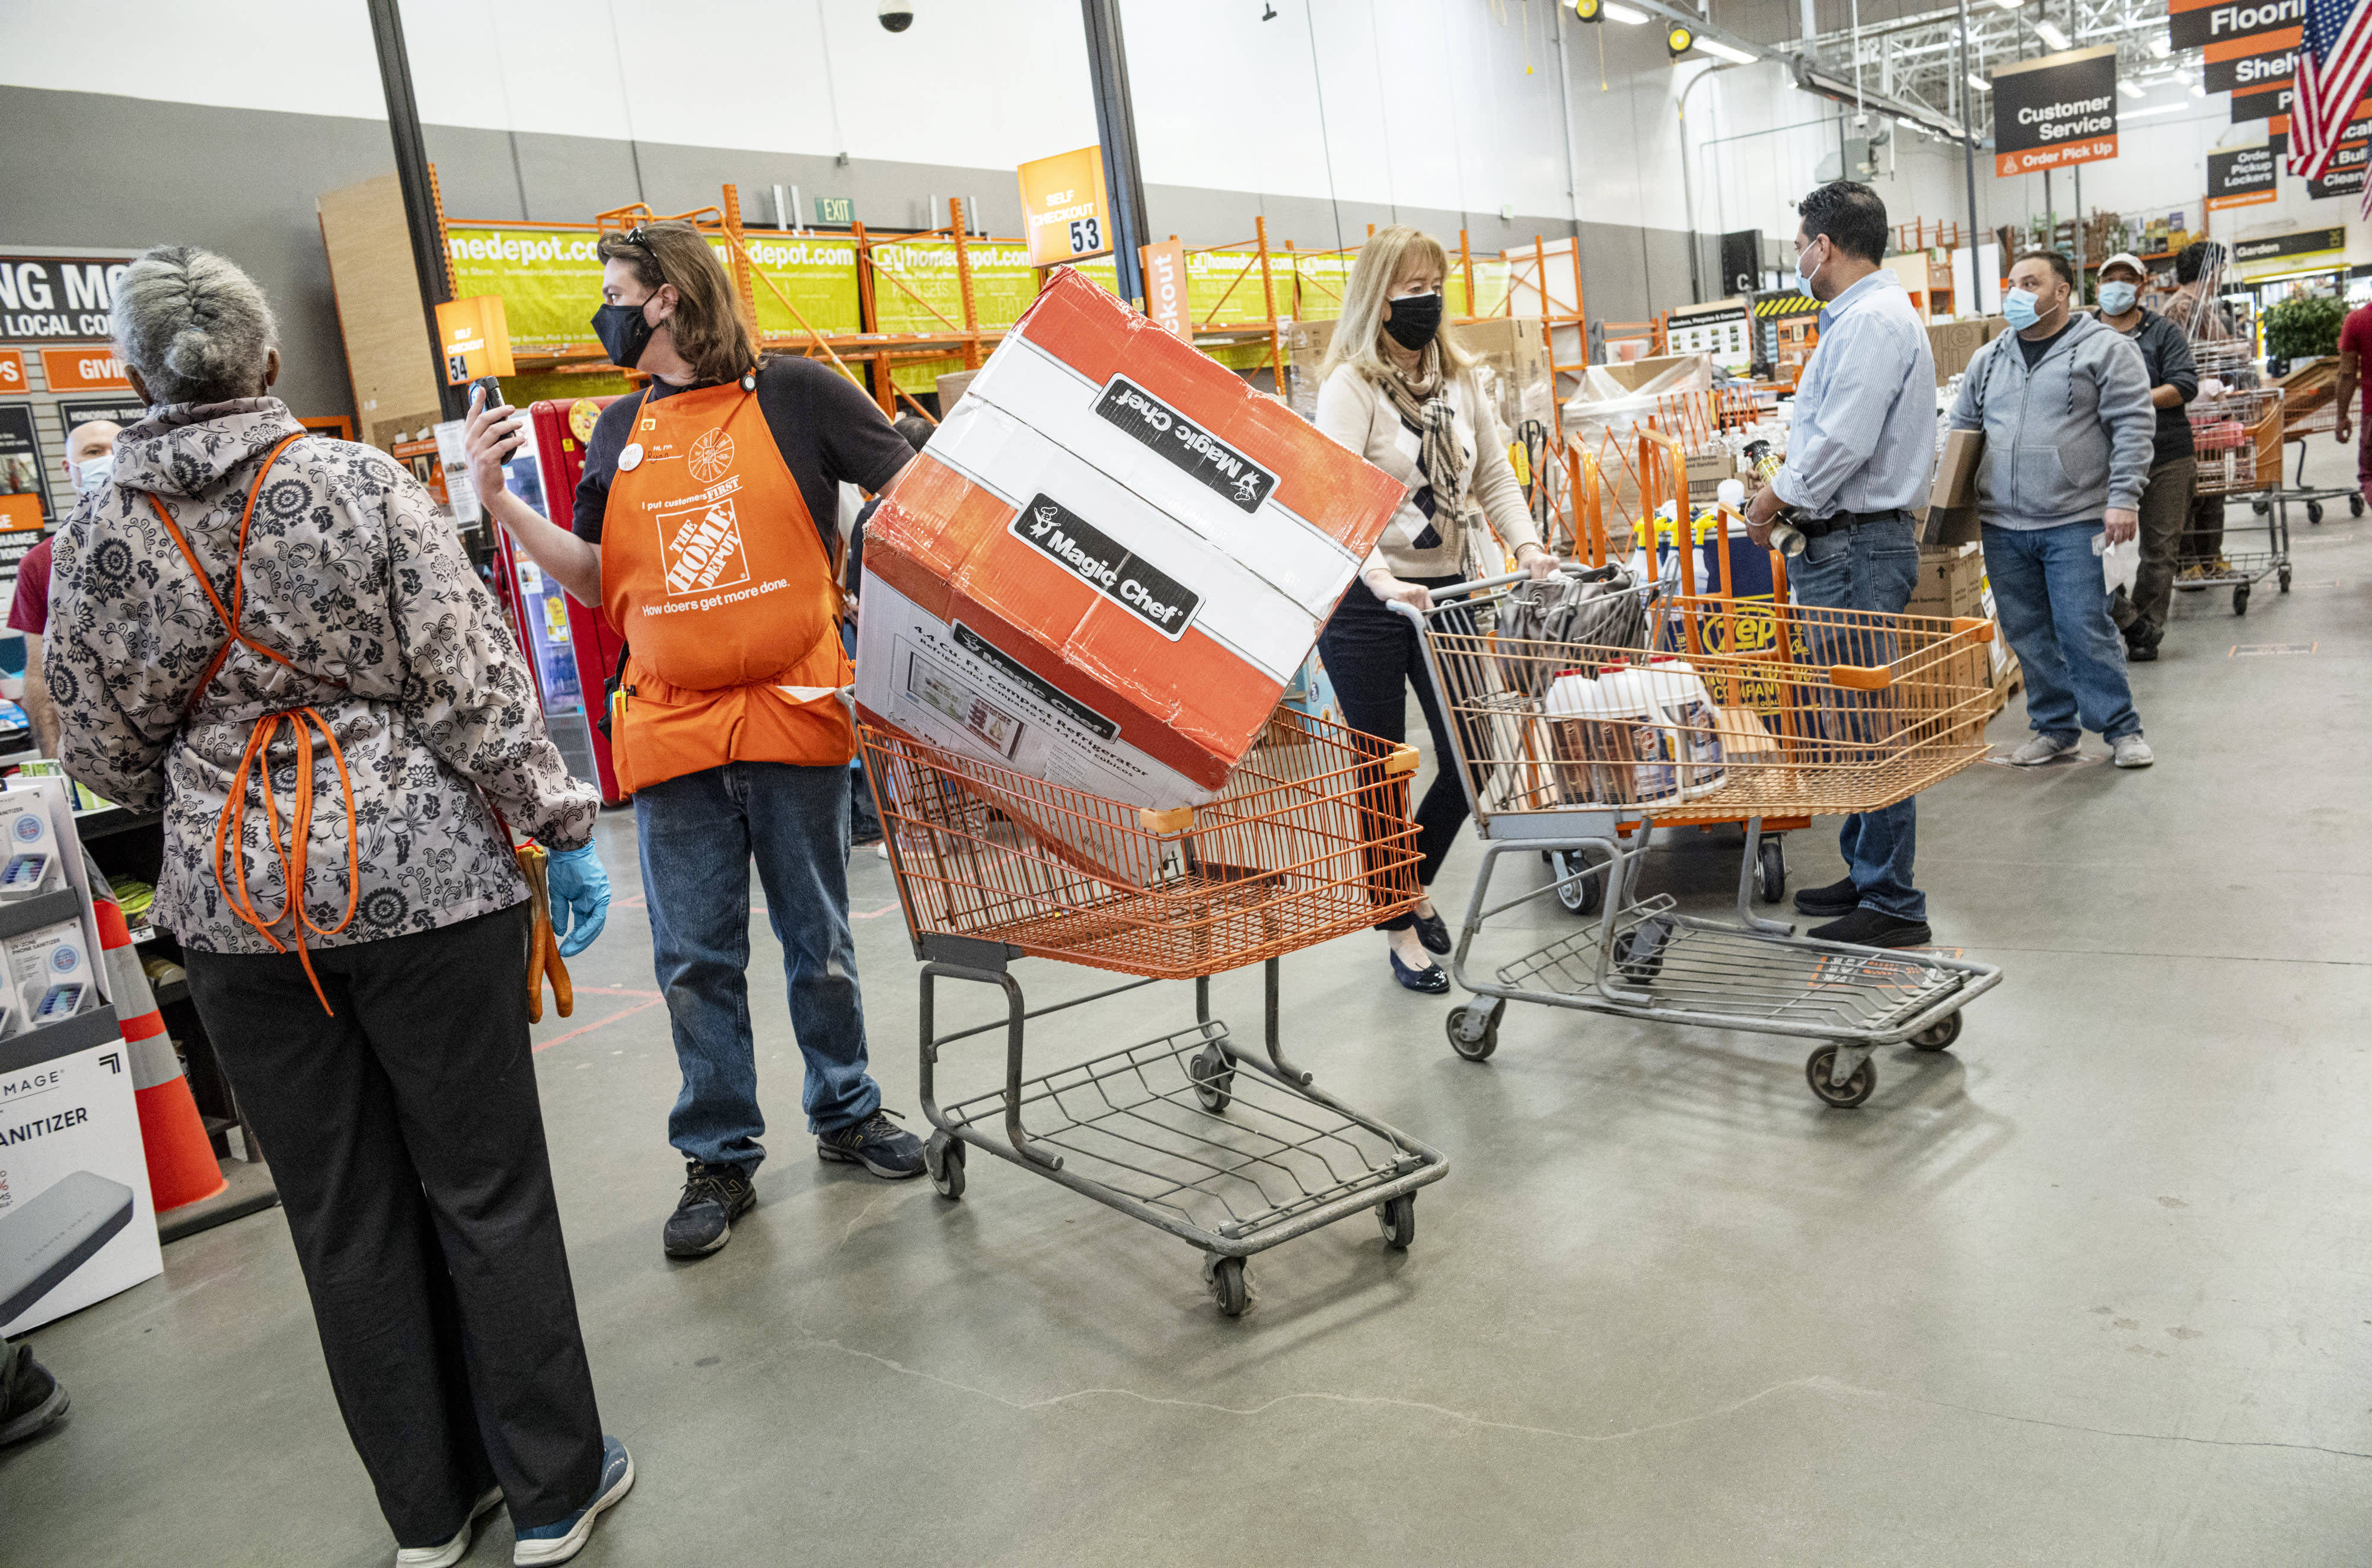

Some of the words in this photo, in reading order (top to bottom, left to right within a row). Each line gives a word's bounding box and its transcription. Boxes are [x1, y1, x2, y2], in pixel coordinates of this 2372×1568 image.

[2018, 96, 2111, 125] Customer
[2039, 116, 2112, 140] Service
[2023, 151, 2059, 167] Order
[2062, 146, 2090, 160] Pick
[2093, 142, 2113, 155] Up
[2237, 151, 2271, 163] Order
[2224, 172, 2272, 187] Lockers
[2231, 161, 2272, 175] Pickup
[2323, 171, 2364, 187] Clean
[824, 199, 850, 222] EXIT
[1046, 190, 1074, 207] SELF
[1032, 203, 1094, 227] CHECKOUT
[1070, 218, 1099, 252] 53
[2237, 243, 2279, 257] Garden
[5, 315, 78, 336] LOCAL
[454, 327, 471, 340] SELF
[447, 339, 484, 355] CHECKOUT
[449, 356, 467, 381] 54
[1115, 389, 1172, 431] Chef
[1175, 425, 1243, 479] Magic
[642, 501, 645, 509] I
[647, 502, 662, 511] put
[664, 493, 707, 508] customers
[706, 478, 739, 500] FIRST
[668, 504, 735, 592] HOME
[669, 519, 698, 554] THE
[697, 530, 740, 588] DEPOT
[1047, 530, 1117, 587] Magic
[1120, 579, 1179, 624] Chef
[642, 604, 662, 617] How
[664, 600, 699, 613] doers
[700, 595, 723, 611] get
[724, 588, 758, 604] more
[760, 578, 790, 594] done.
[914, 626, 935, 642] 4.4
[939, 641, 961, 660] Cu.
[965, 659, 983, 675] Ft.
[988, 674, 1054, 719] Compact
[1057, 719, 1149, 776] Refrigerator
[920, 638, 984, 682] Refrigerador
[986, 683, 1037, 718] compacto
[1039, 718, 1052, 728] de
[1054, 727, 1069, 739] 4.4
[1071, 738, 1092, 754] pies
[983, 651, 1047, 699] Magic
[1051, 699, 1102, 734] Chef
